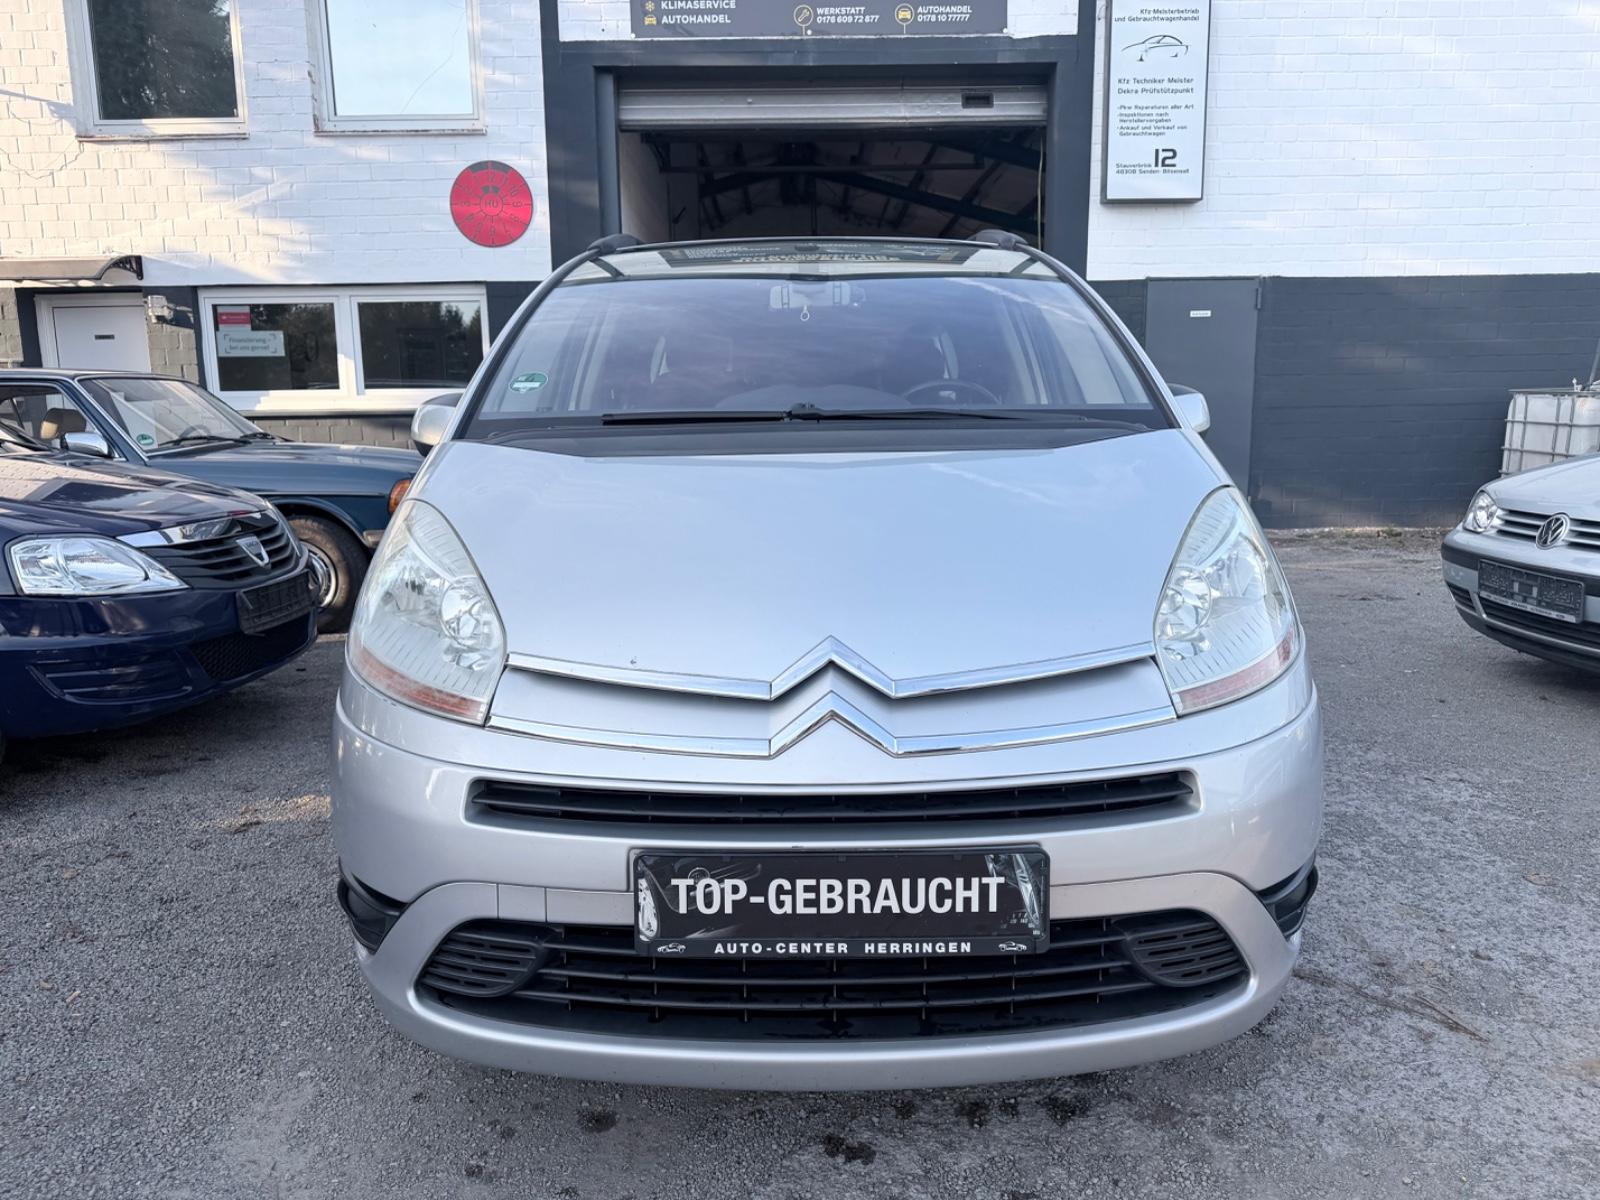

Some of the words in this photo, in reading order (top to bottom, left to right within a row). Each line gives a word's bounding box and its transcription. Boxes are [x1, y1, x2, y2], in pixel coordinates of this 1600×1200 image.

[661, 0, 736, 9] KLIMASERVICE
[917, 5, 973, 13] AUTOHANDEL
[816, 7, 866, 15] WERKSTATT
[661, 14, 731, 24] AUTOHANDEL
[1154, 148, 1177, 168] 12
[670, 876, 1005, 915] TOP-GEBRAUCHT
[714, 942, 849, 954] AUTO-CENTER
[864, 942, 971, 953] HERRINGEN
